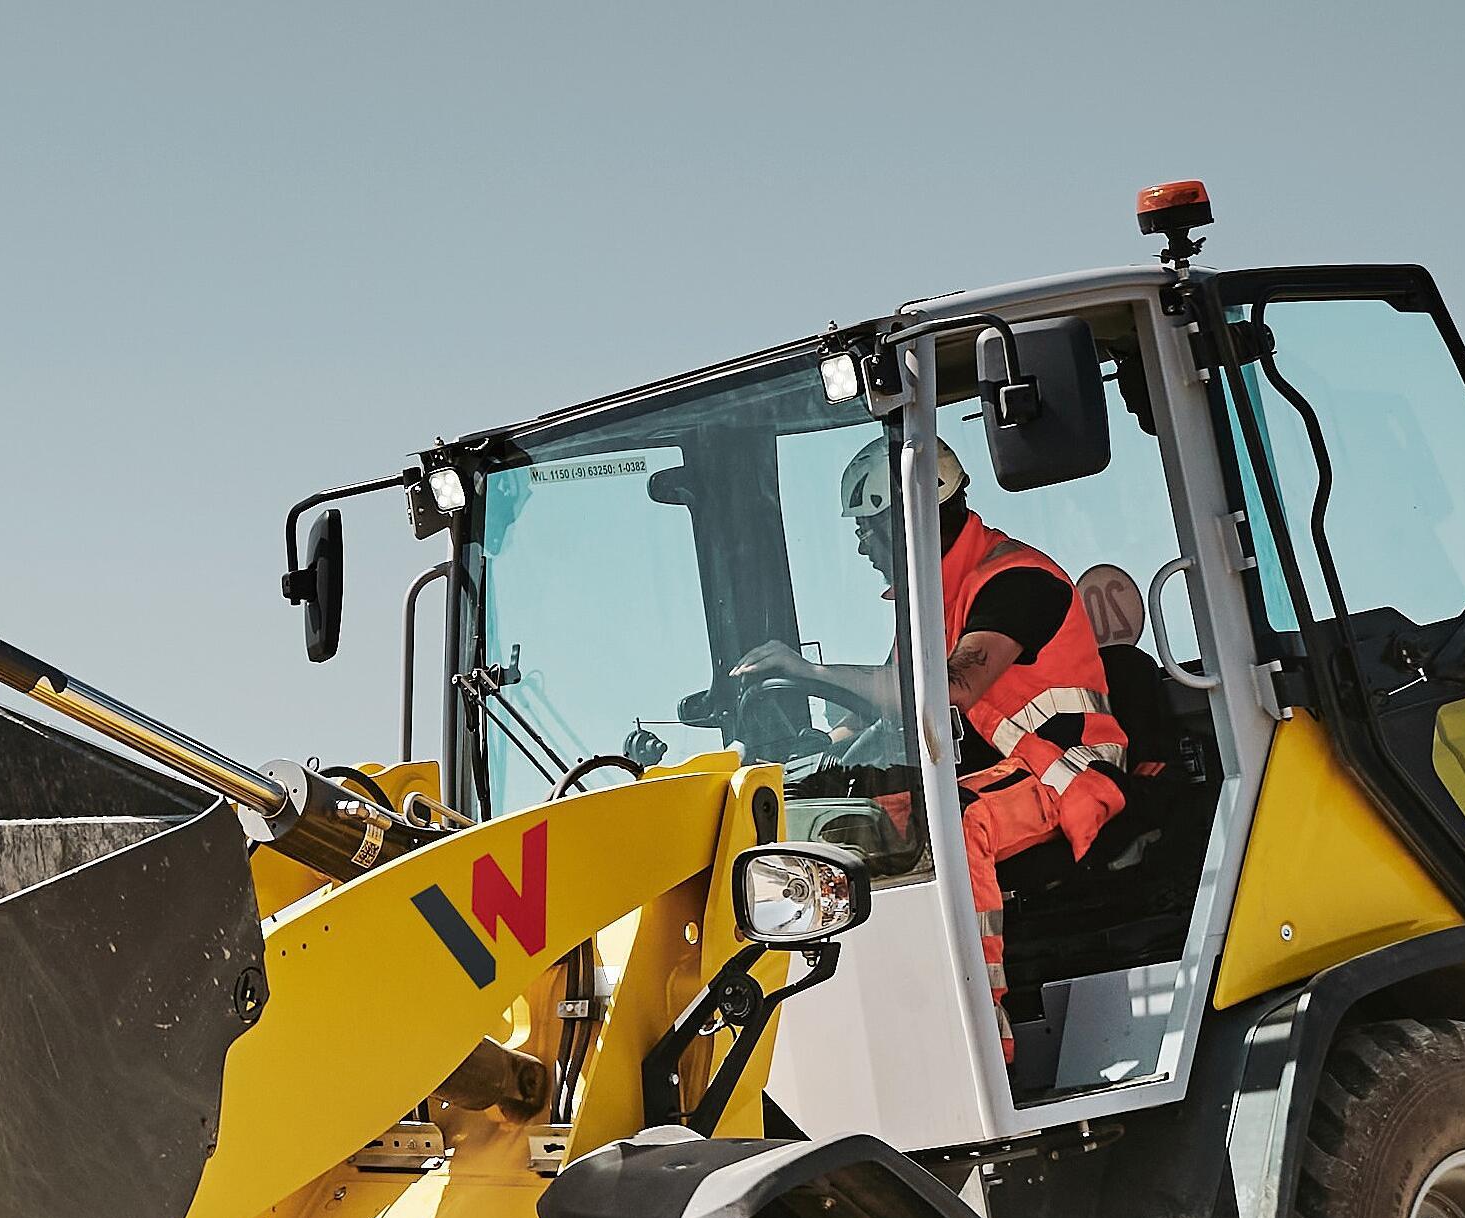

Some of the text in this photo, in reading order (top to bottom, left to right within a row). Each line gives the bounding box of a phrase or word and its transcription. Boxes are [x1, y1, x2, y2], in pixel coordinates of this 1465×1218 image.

[532, 470, 548, 482] WL
[550, 468, 570, 481] 1150
[572, 467, 587, 479] (-9)
[618, 460, 646, 473] 1-0382
[410, 819, 547, 990] W
